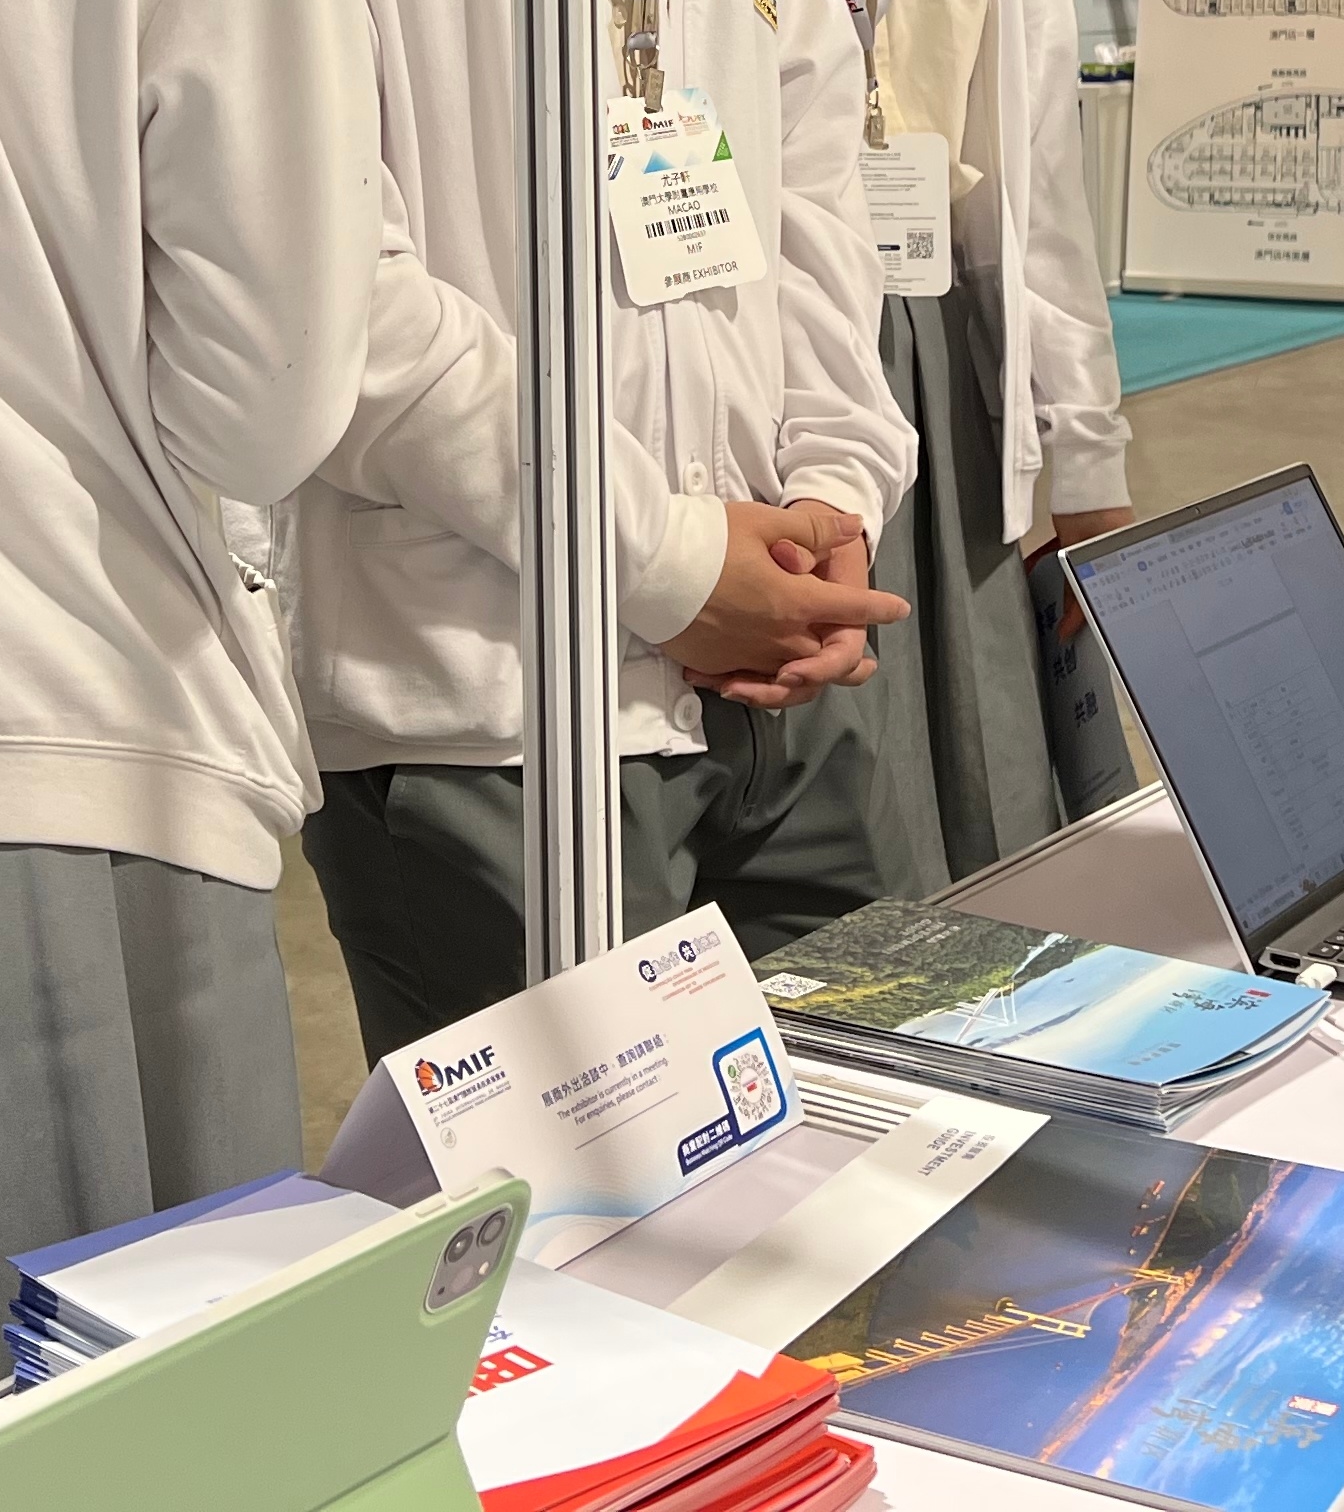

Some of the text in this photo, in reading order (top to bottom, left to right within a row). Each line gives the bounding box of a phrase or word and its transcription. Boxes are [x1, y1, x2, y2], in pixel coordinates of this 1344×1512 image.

[668, 200, 701, 215] MACAO
[686, 242, 703, 255] MIF
[693, 261, 739, 280] EXHIBITOR
[444, 1045, 495, 1086] MIF
[917, 1131, 977, 1176] INVESTMENT
